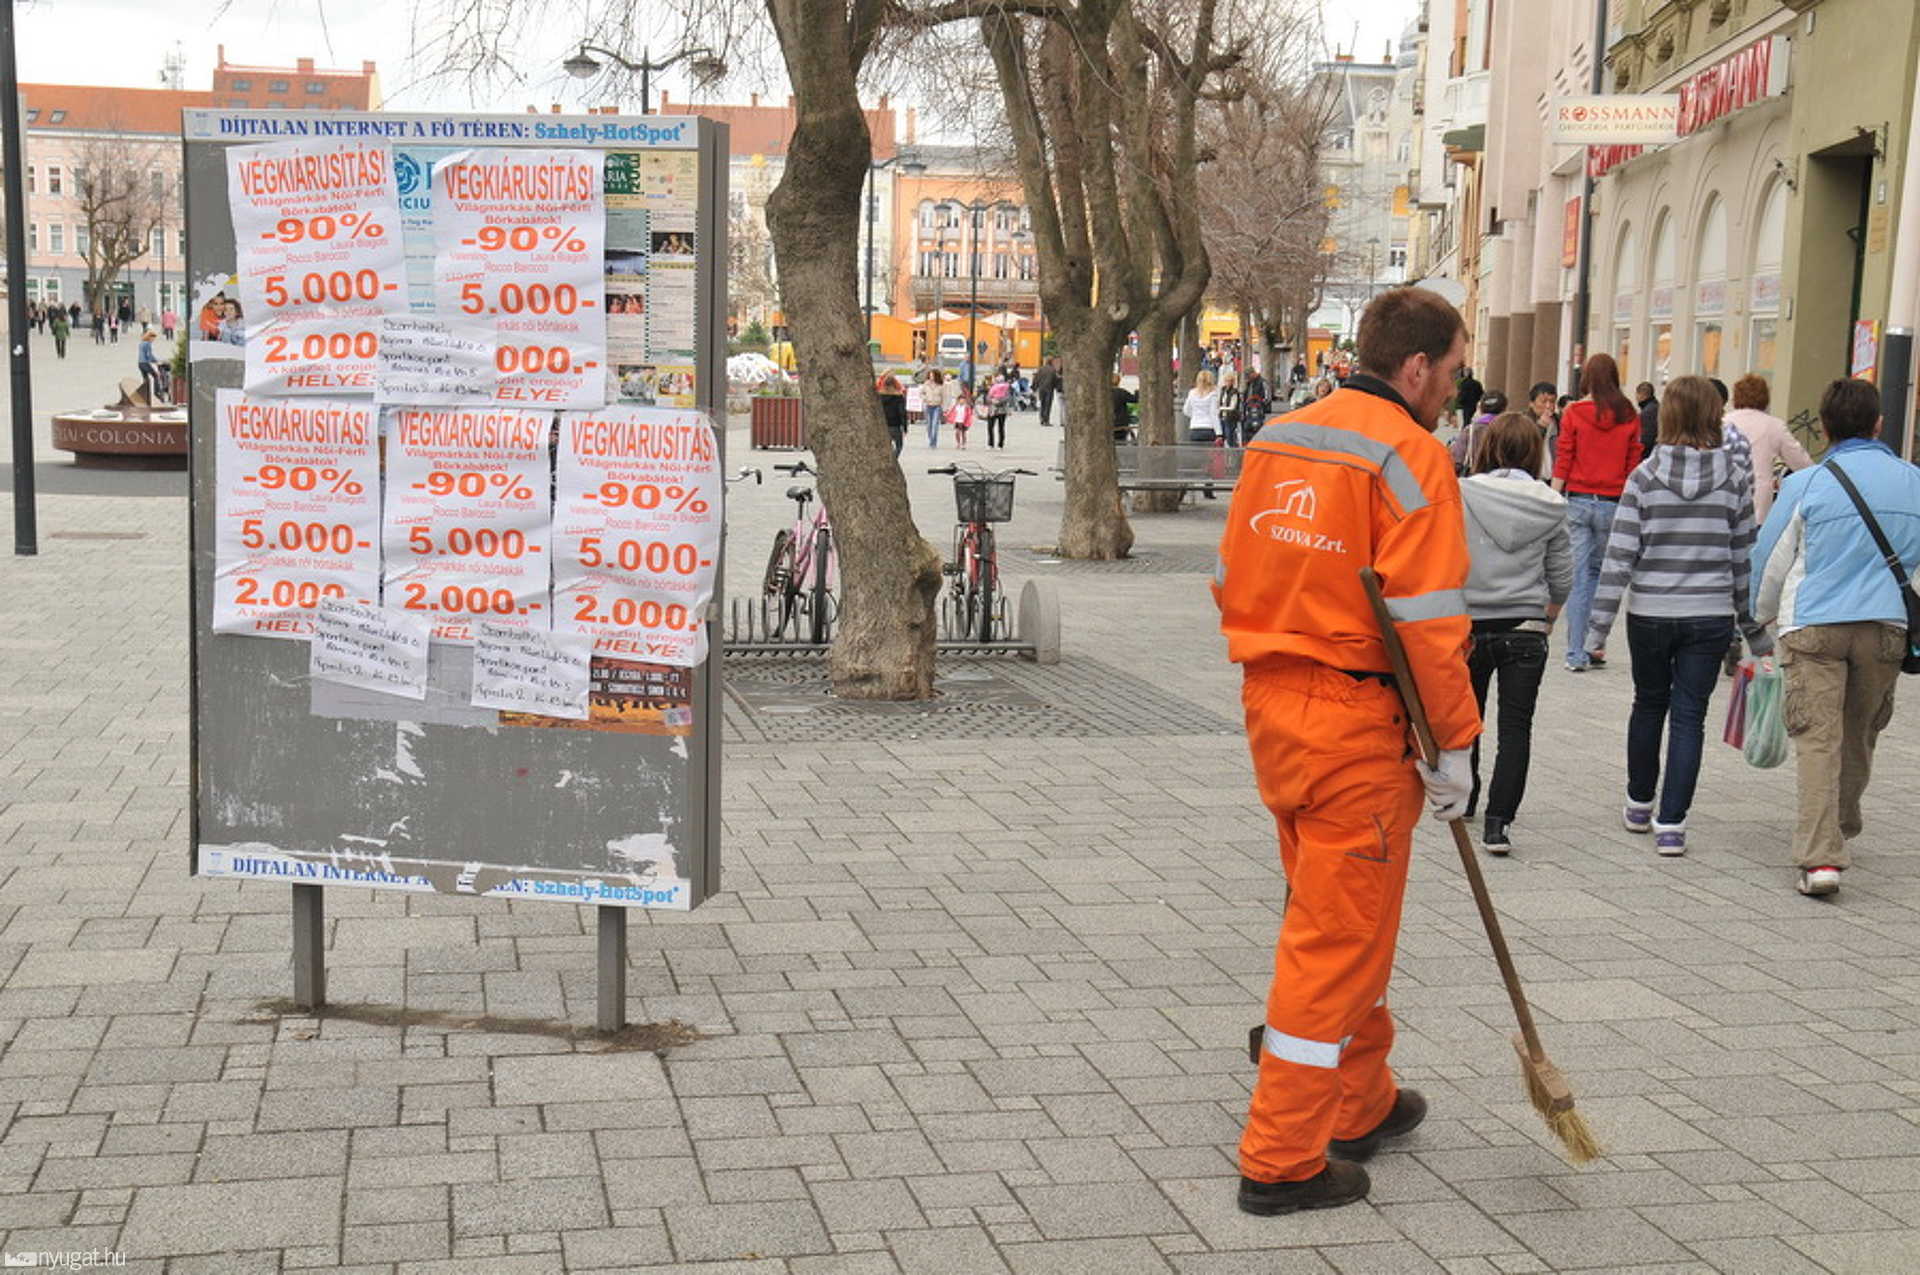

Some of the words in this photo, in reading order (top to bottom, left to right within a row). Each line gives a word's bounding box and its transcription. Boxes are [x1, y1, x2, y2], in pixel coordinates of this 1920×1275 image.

[220, 115, 308, 137] DÍJTALAN
[315, 118, 407, 137] INTERNET
[413, 119, 430, 137] A
[431, 118, 455, 138] FŐ
[458, 118, 529, 139] TÉREN:
[1558, 106, 1676, 121] ROSSMANN
[239, 143, 387, 196] VÉGKIÁRUSÍTÁS!
[445, 156, 594, 201] VÉGKIÁRUSÍTÁS!
[261, 212, 384, 243] -90%
[461, 226, 586, 252] -90%
[265, 268, 398, 307] 5.000-
[461, 283, 595, 315] 5.000-
[264, 331, 379, 363] 2.000
[496, 346, 598, 375] 000.-
[496, 387, 569, 401] ELYE:
[243, 465, 363, 495] -90%
[411, 471, 533, 500] -90%
[582, 482, 709, 513] -90%
[242, 519, 370, 555] 5.000-
[409, 526, 541, 559] 5.000-
[1313, 534, 1347, 553] Zrt.
[578, 537, 711, 575] 5.000-
[404, 583, 541, 615] 2.000.-
[256, 620, 318, 634] HELY
[593, 639, 683, 658] HELYE:
[233, 856, 317, 877] DÍJTALAN
